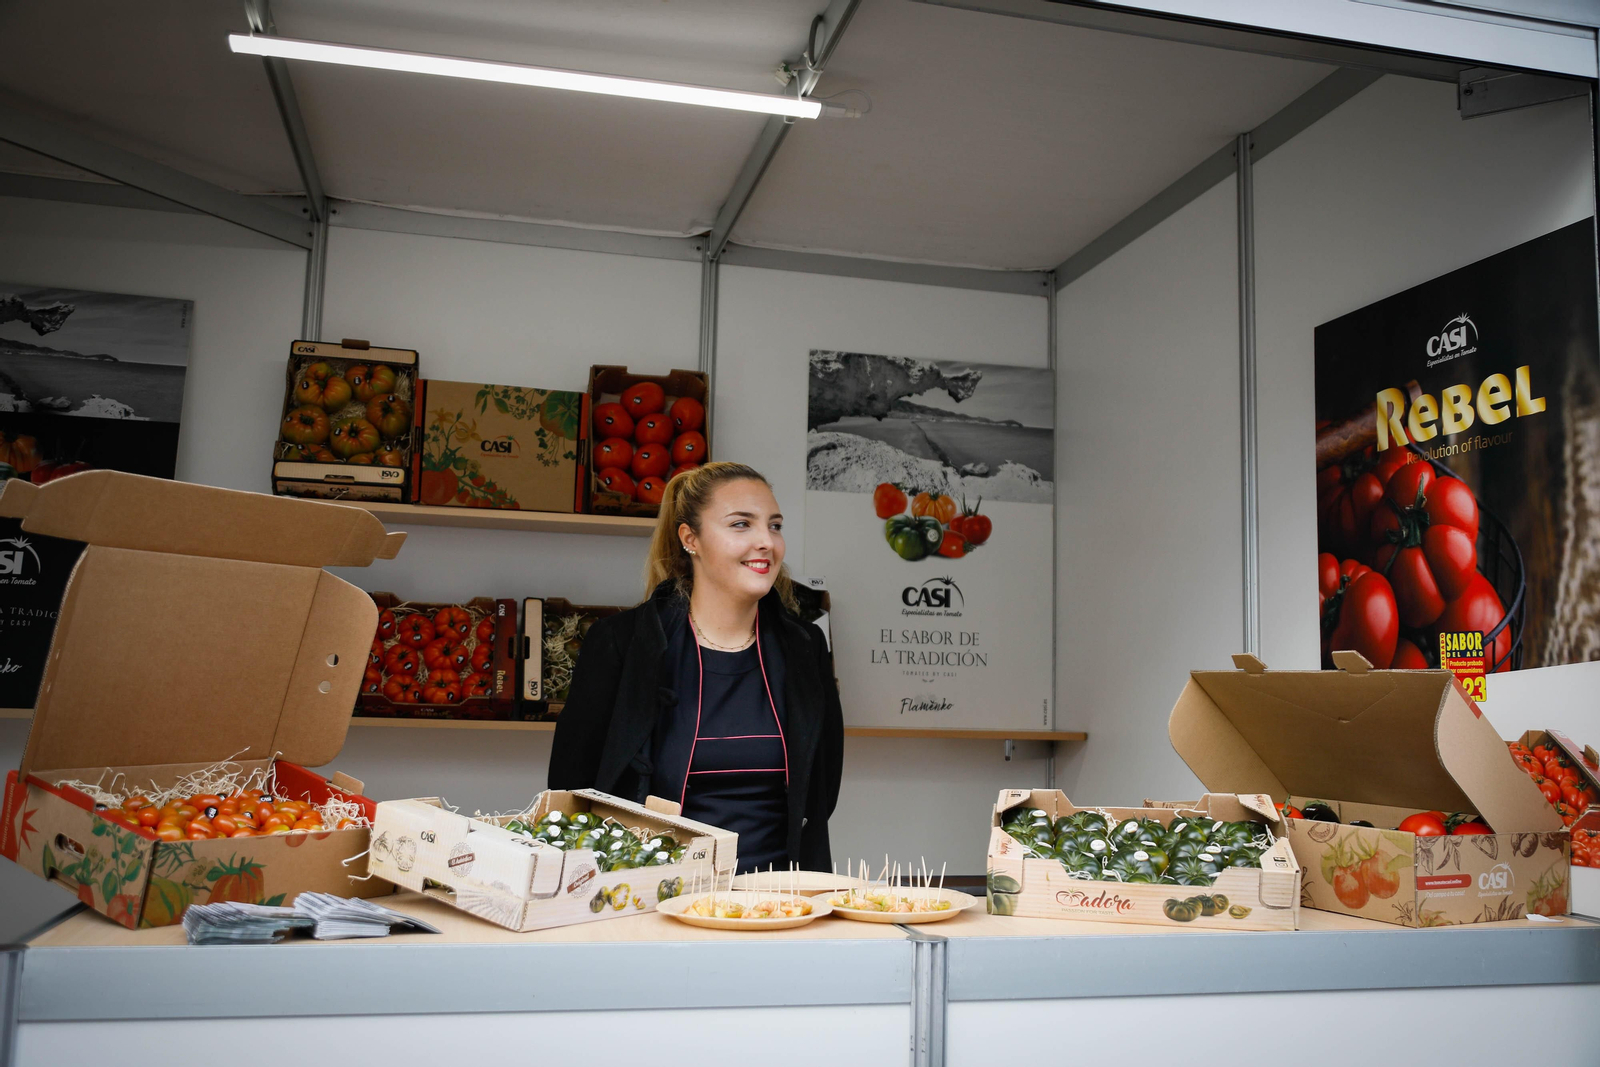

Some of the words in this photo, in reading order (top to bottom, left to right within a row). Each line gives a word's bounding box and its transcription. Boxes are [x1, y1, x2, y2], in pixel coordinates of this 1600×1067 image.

[1426, 325, 1467, 357] CASI
[1426, 355, 1454, 368] Especialistas
[1460, 346, 1477, 356] Tomate
[481, 440, 512, 453] CASI
[1406, 443, 1459, 465] Revolution
[1461, 437, 1473, 453] of
[1474, 432, 1513, 450] flavour
[381, 470, 399, 478] CASI
[0, 550, 24, 575] SI
[10, 577, 37, 585] Tomate
[902, 586, 951, 608] CASI
[10, 606, 57, 619] TRADIC
[901, 608, 935, 617] Especialistas
[10, 619, 31, 627] CASI
[880, 629, 896, 643] EL
[901, 629, 953, 645] SABOR
[960, 631, 980, 646] DE
[1446, 632, 1483, 651] SABOR
[871, 649, 889, 664] LA
[895, 649, 988, 667] TRADICIÓN
[1462, 676, 1487, 702] 23
[420, 831, 436, 843] CASI
[692, 851, 706, 860] CASI
[1478, 872, 1507, 889] CASI
